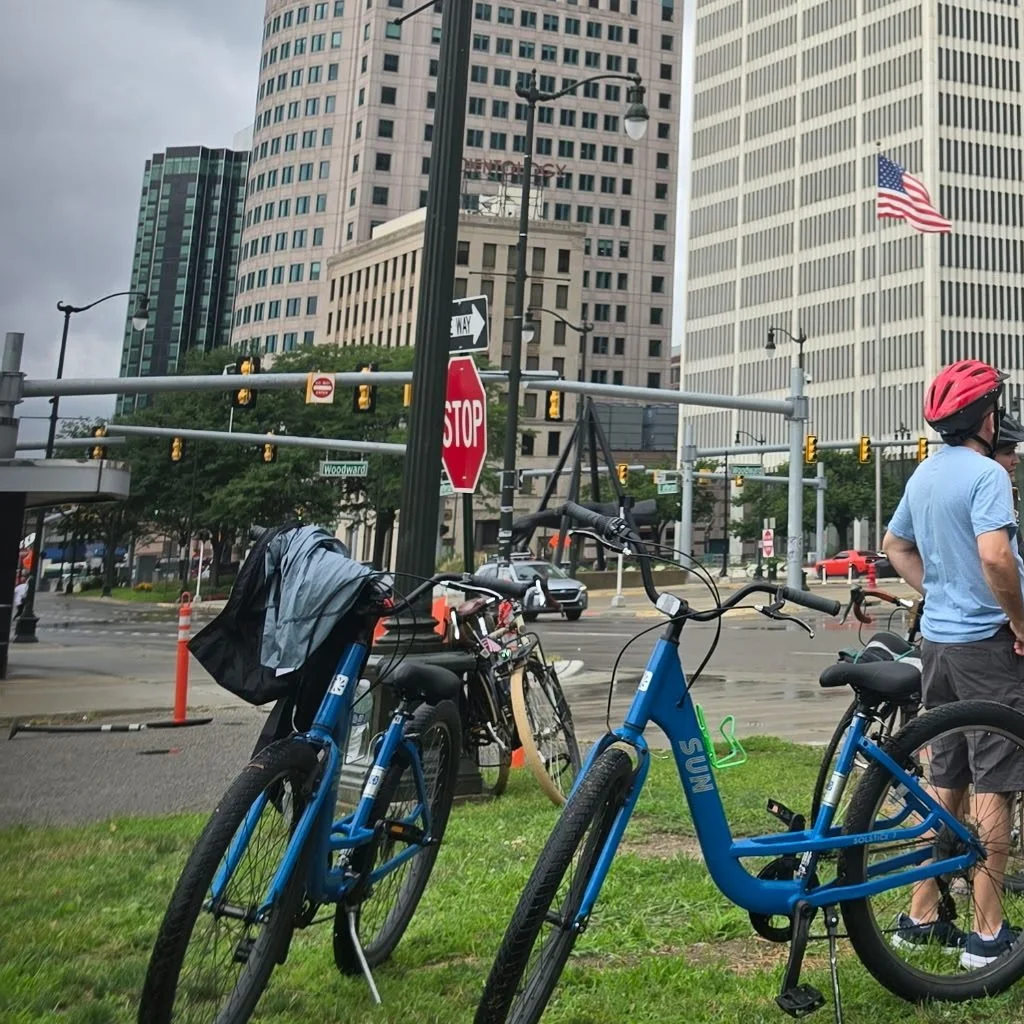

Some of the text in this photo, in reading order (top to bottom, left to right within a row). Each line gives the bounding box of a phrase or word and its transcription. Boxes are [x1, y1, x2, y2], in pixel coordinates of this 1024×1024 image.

[455, 315, 472, 336] WAY
[443, 399, 483, 449] STOP
[324, 464, 366, 475] Woodward
[678, 737, 714, 794] SUN
[853, 833, 889, 844] SOLSTICE
